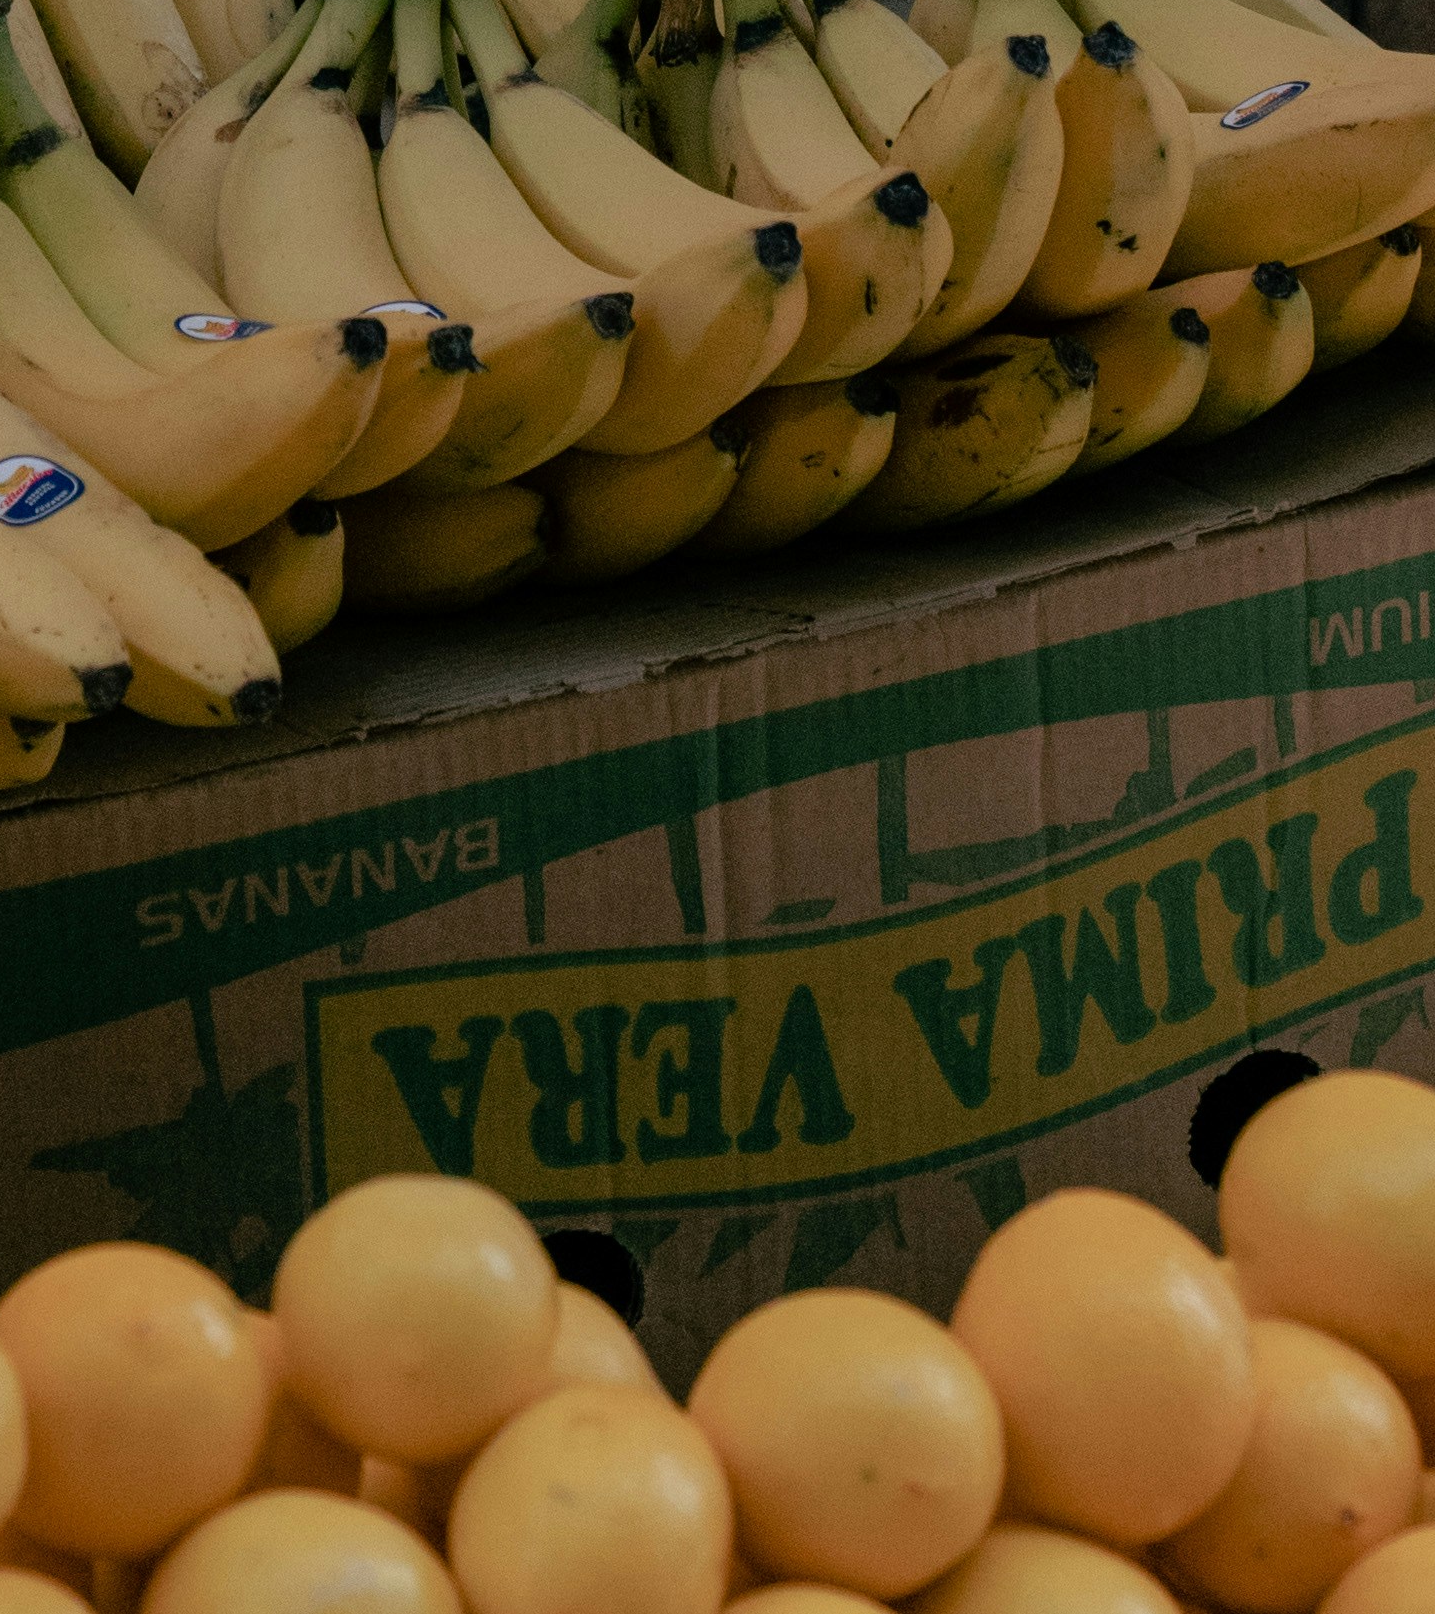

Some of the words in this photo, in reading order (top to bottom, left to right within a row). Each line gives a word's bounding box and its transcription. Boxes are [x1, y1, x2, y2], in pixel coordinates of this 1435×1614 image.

[134, 816, 501, 949] BANANAS
[892, 768, 1425, 1110] PRIMA
[371, 983, 856, 1176] VERA
